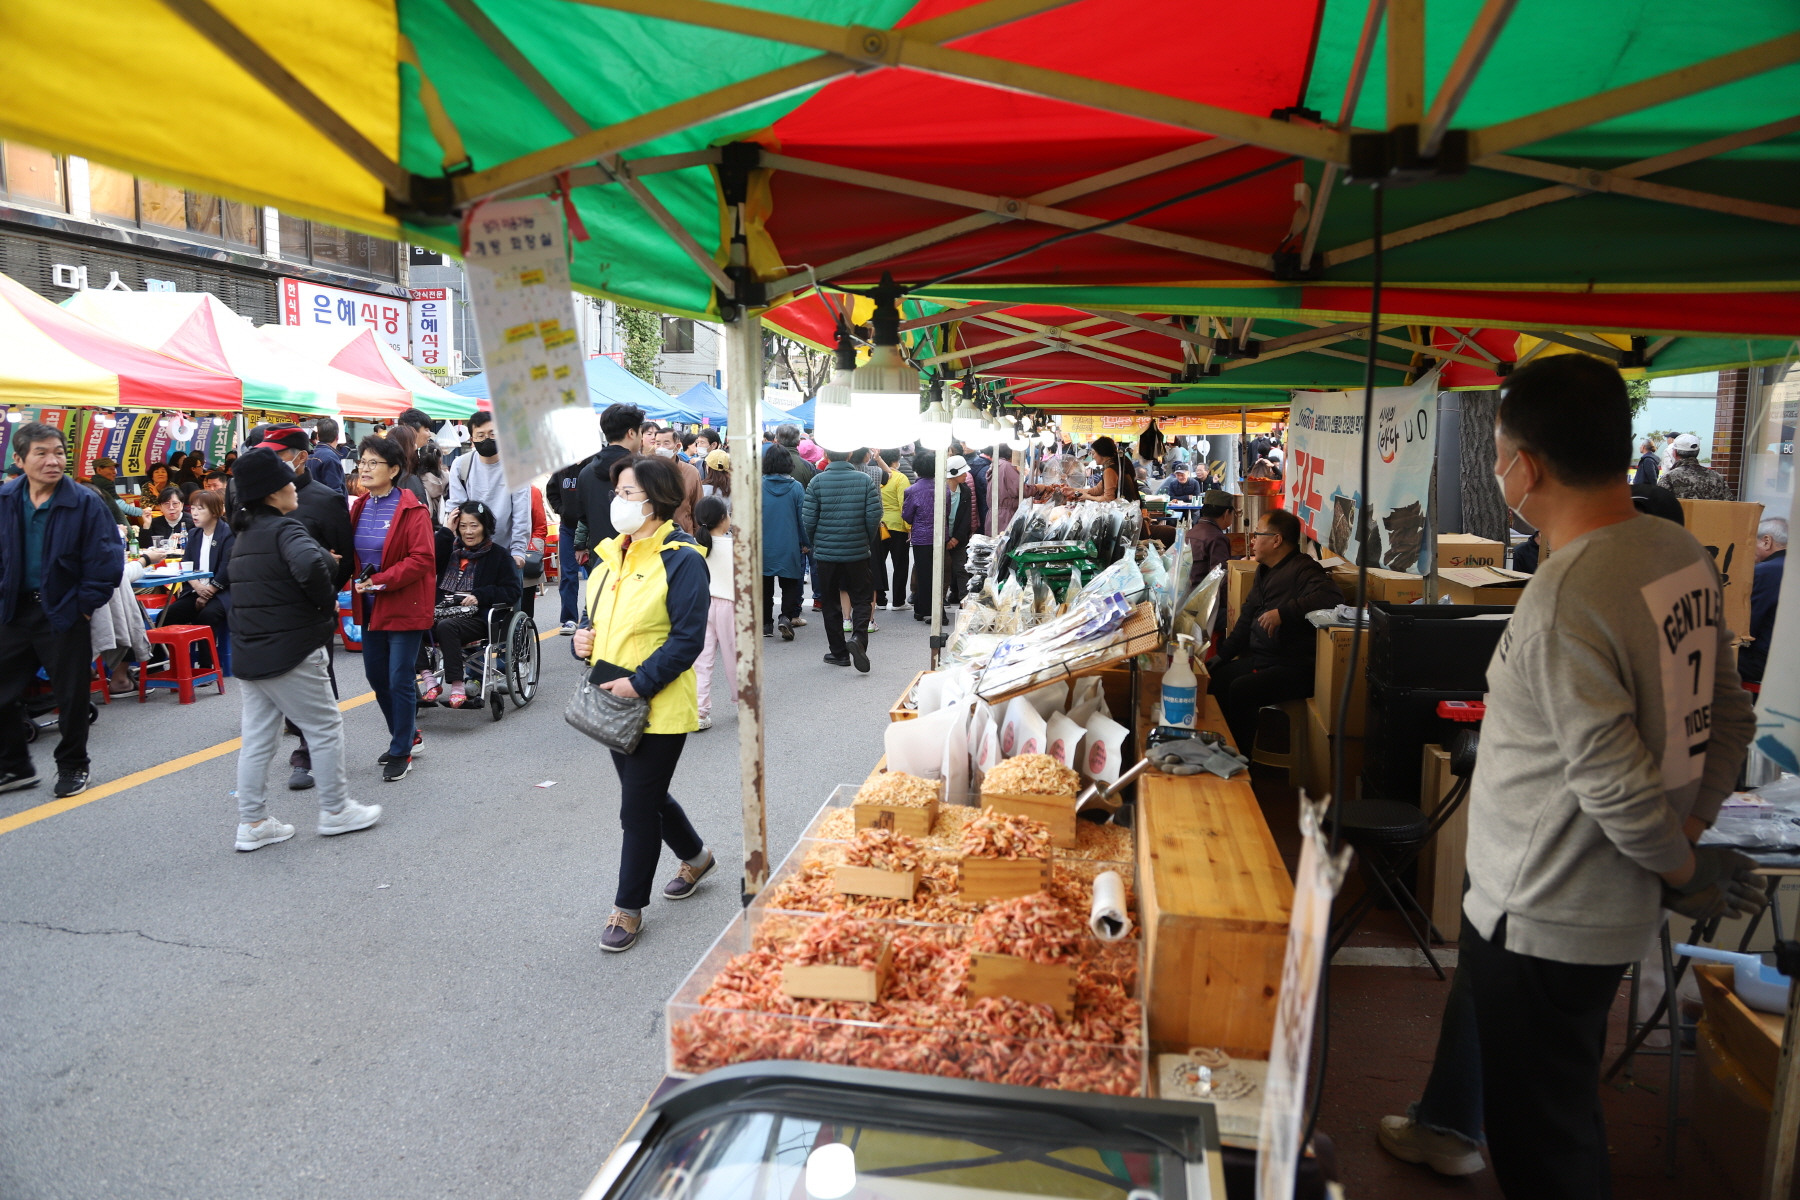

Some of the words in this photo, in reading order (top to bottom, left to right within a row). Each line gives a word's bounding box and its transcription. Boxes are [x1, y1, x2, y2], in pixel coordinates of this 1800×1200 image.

[313, 294, 400, 335] 은혜식당
[420, 303, 440, 364] 은혜식당
[107, 415, 131, 472] 순대볶
[127, 416, 153, 474] 해물파전
[1663, 587, 1720, 655] GENTLE
[1688, 649, 1702, 696] 7
